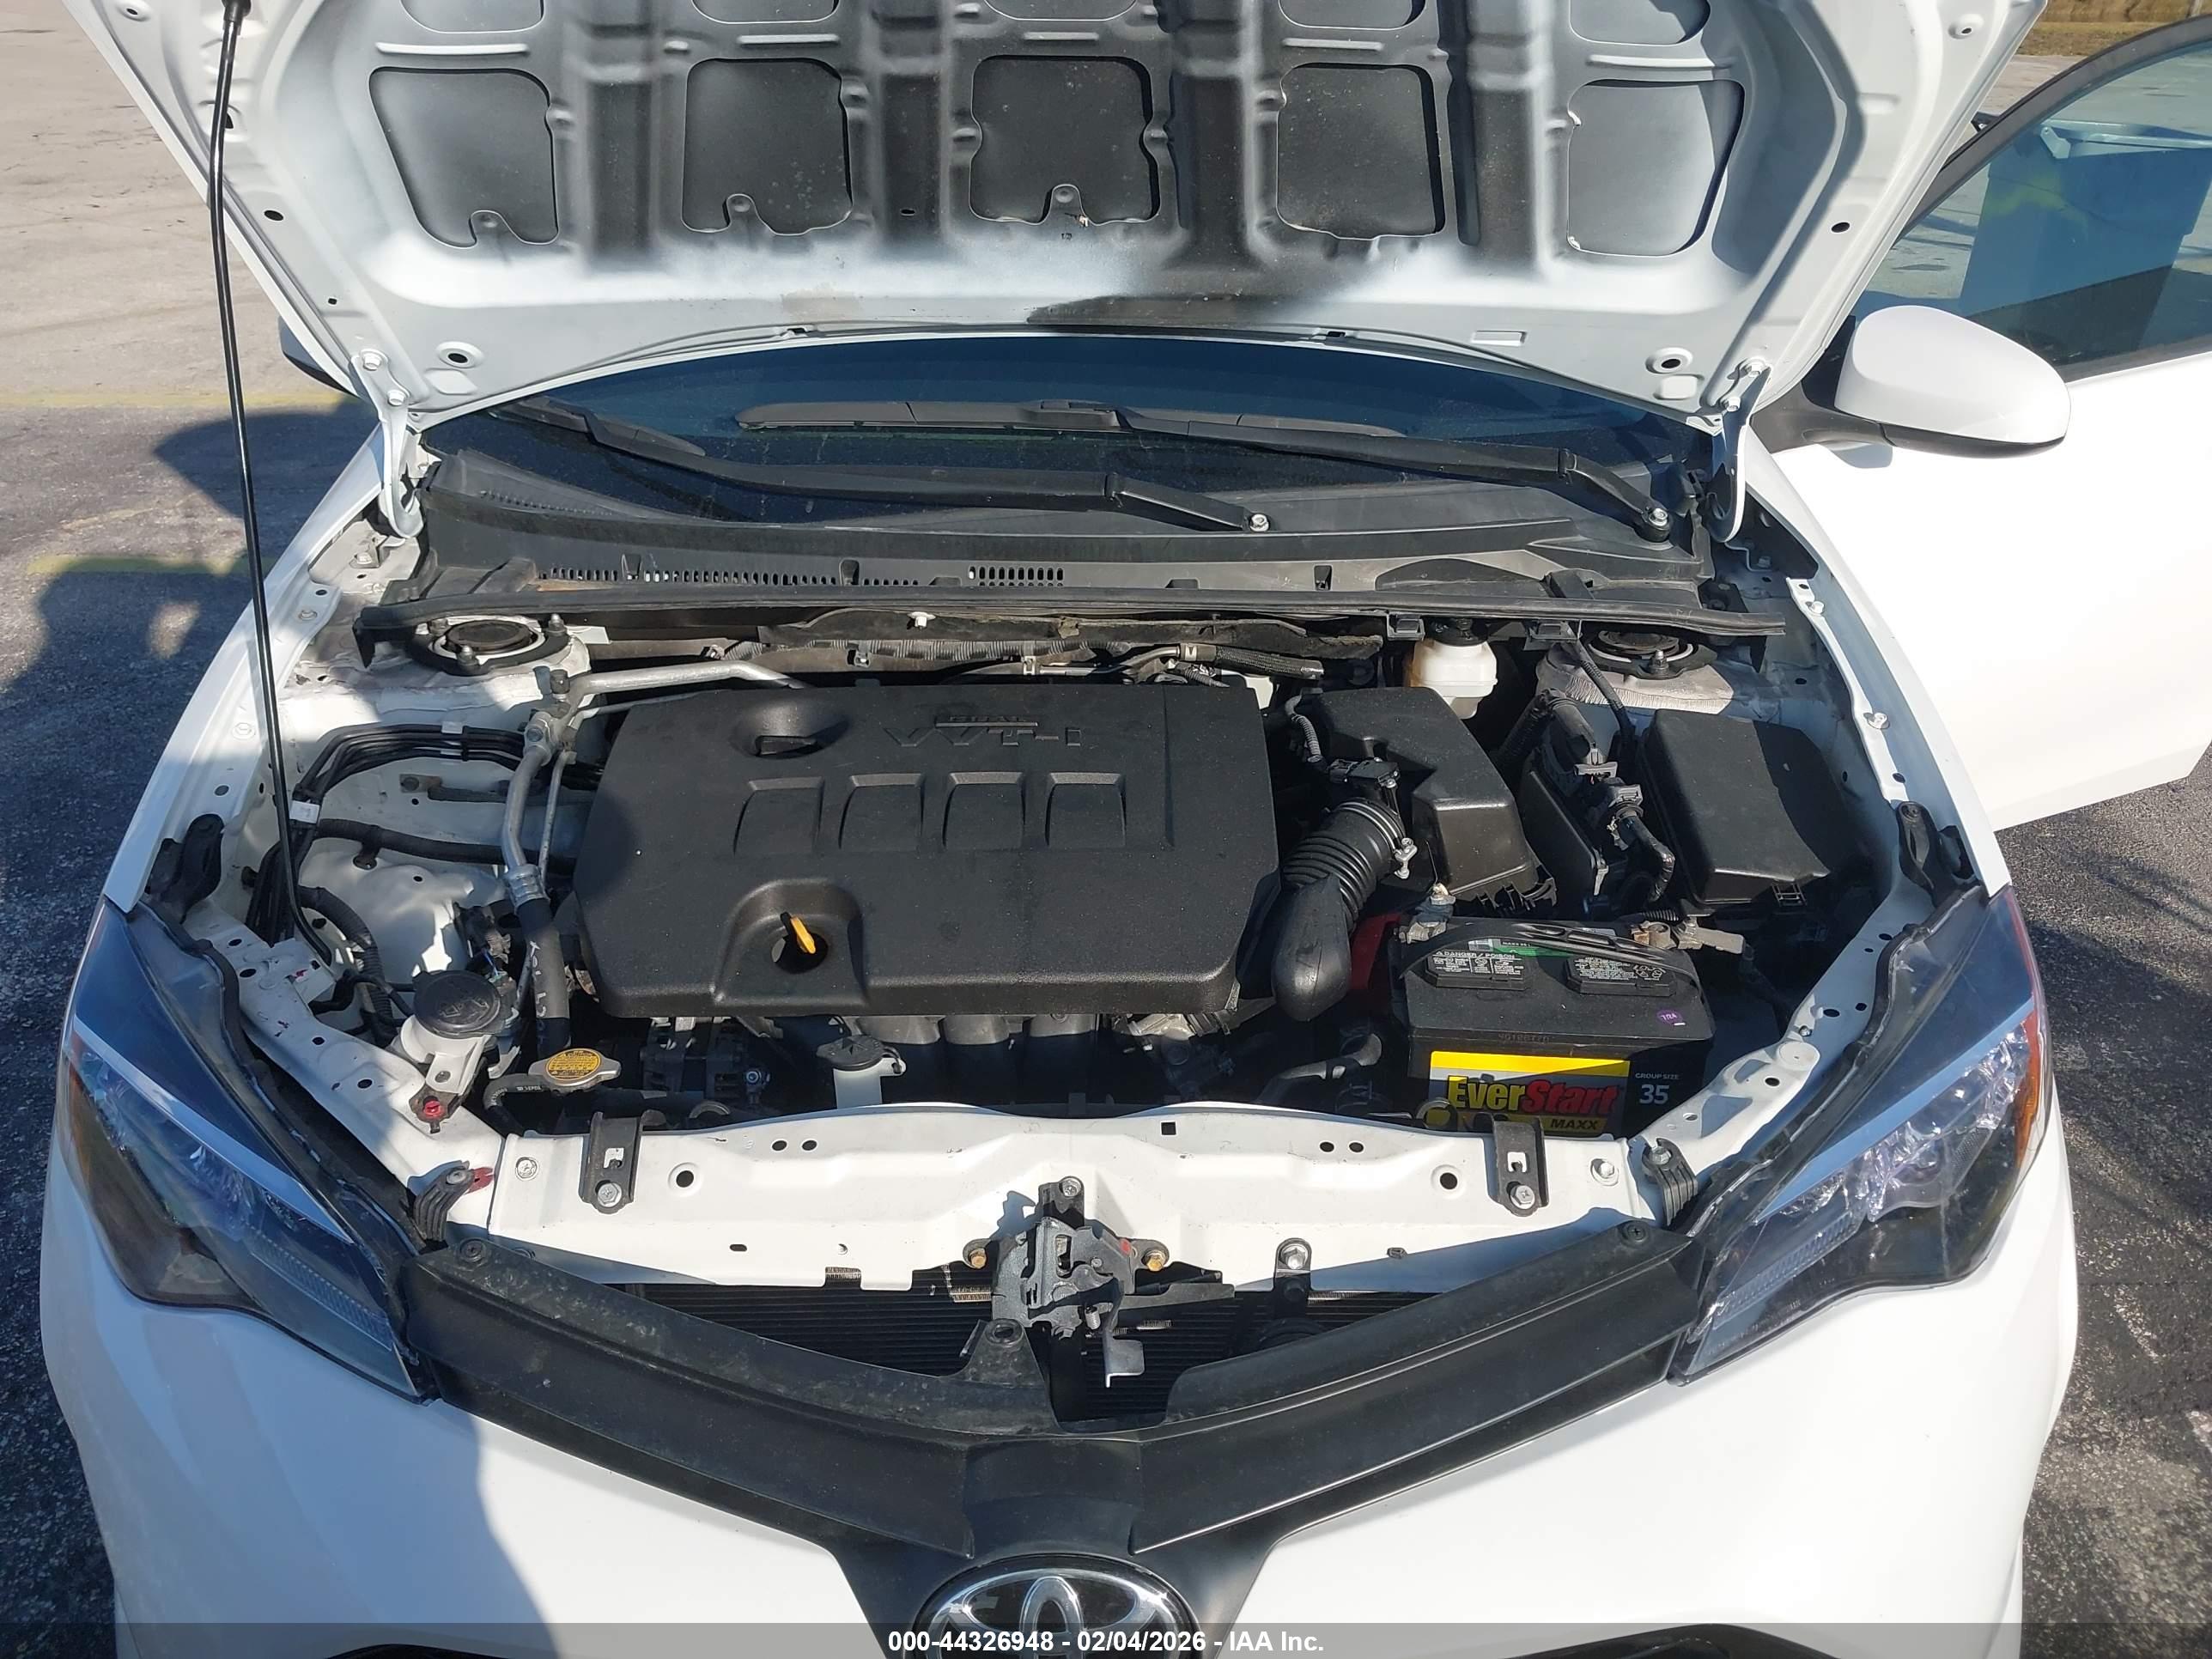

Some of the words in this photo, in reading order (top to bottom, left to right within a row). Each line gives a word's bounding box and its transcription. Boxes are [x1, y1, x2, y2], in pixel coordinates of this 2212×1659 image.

[1447, 1075, 1620, 1115] EverStart
[1638, 1084, 1670, 1105] 35
[1549, 1118, 1599, 1131] MAXX
